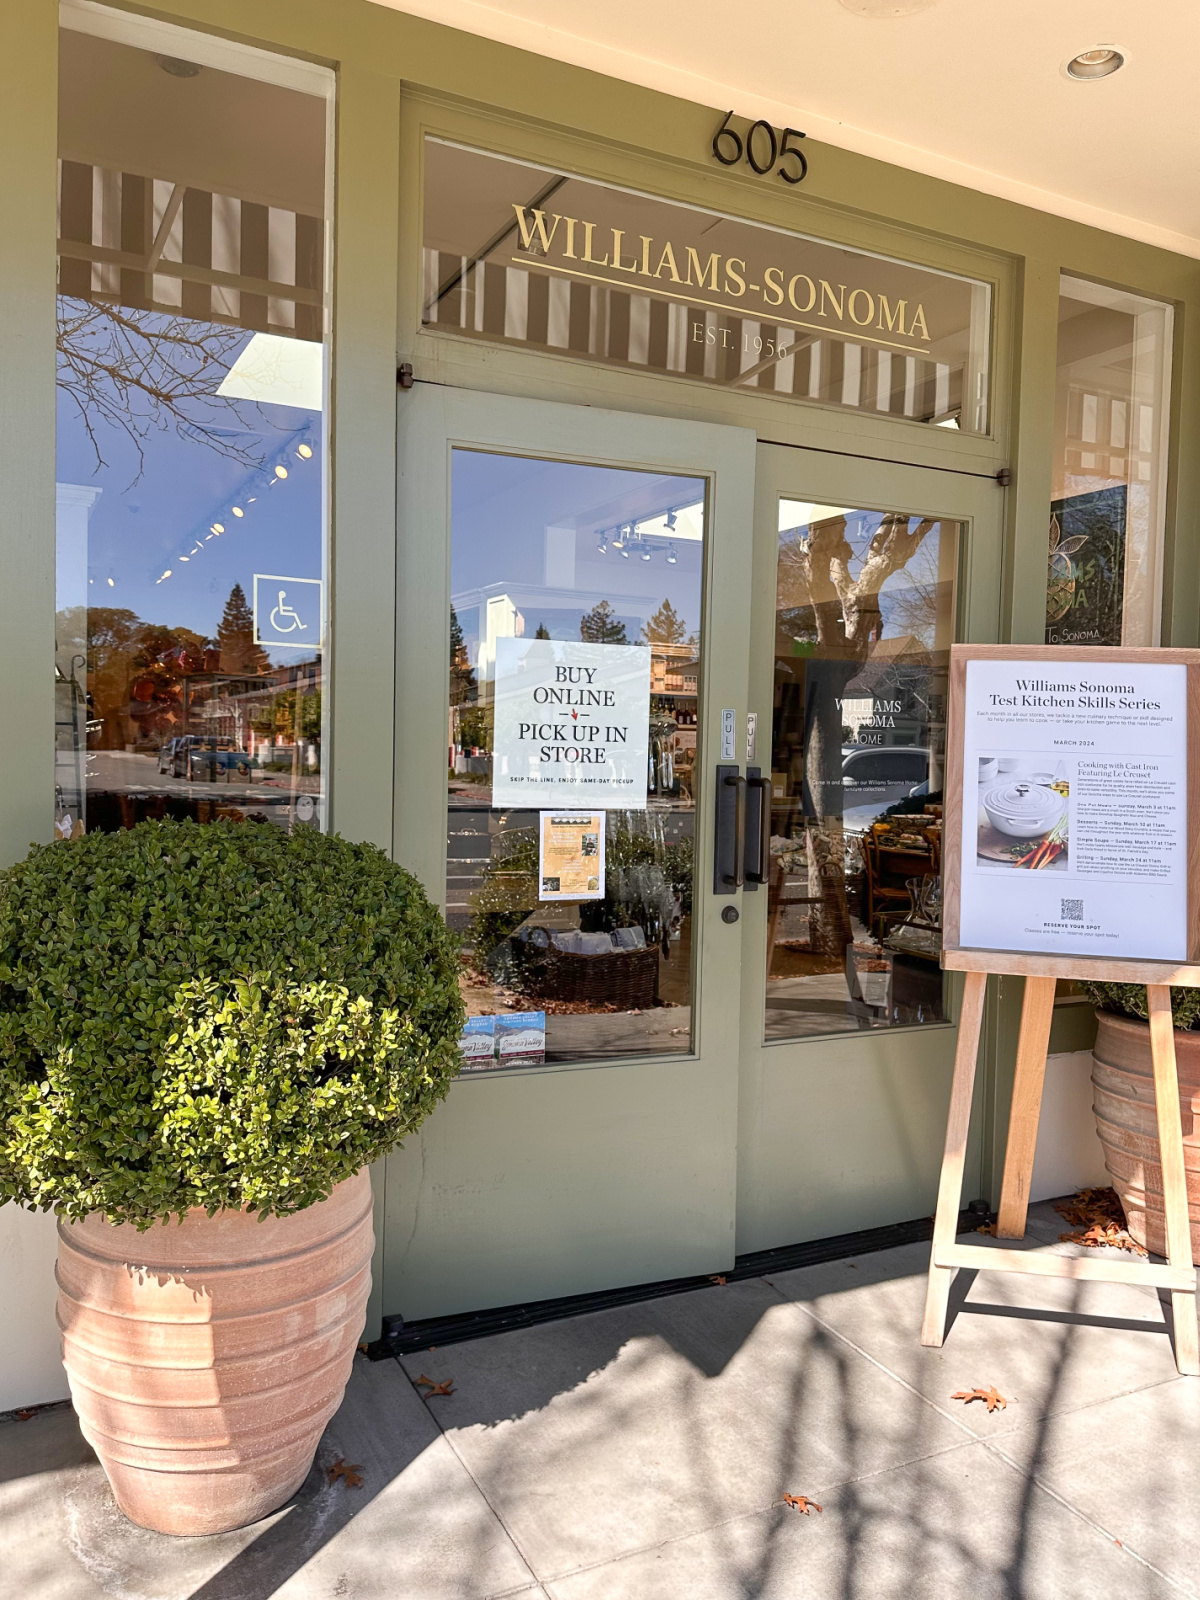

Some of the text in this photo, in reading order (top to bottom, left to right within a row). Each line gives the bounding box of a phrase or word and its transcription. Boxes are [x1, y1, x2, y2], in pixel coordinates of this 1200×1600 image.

[712, 110, 808, 184] 605
[511, 203, 932, 341] WILLIAMS-SONOMA
[692, 322, 788, 360] EST. 1956
[555, 665, 597, 684] BUY
[1015, 679, 1135, 694] Williams Sonoma
[533, 686, 616, 707] ONLINE
[834, 698, 902, 713] WILLIAMS
[989, 694, 1161, 710] Test Kitchen Skills Series
[842, 714, 896, 728] SONOMA
[518, 723, 628, 743] PICK UP IN
[540, 746, 606, 764] STORE
[1078, 761, 1108, 770] Cooking
[1078, 769, 1111, 778] Featuring
